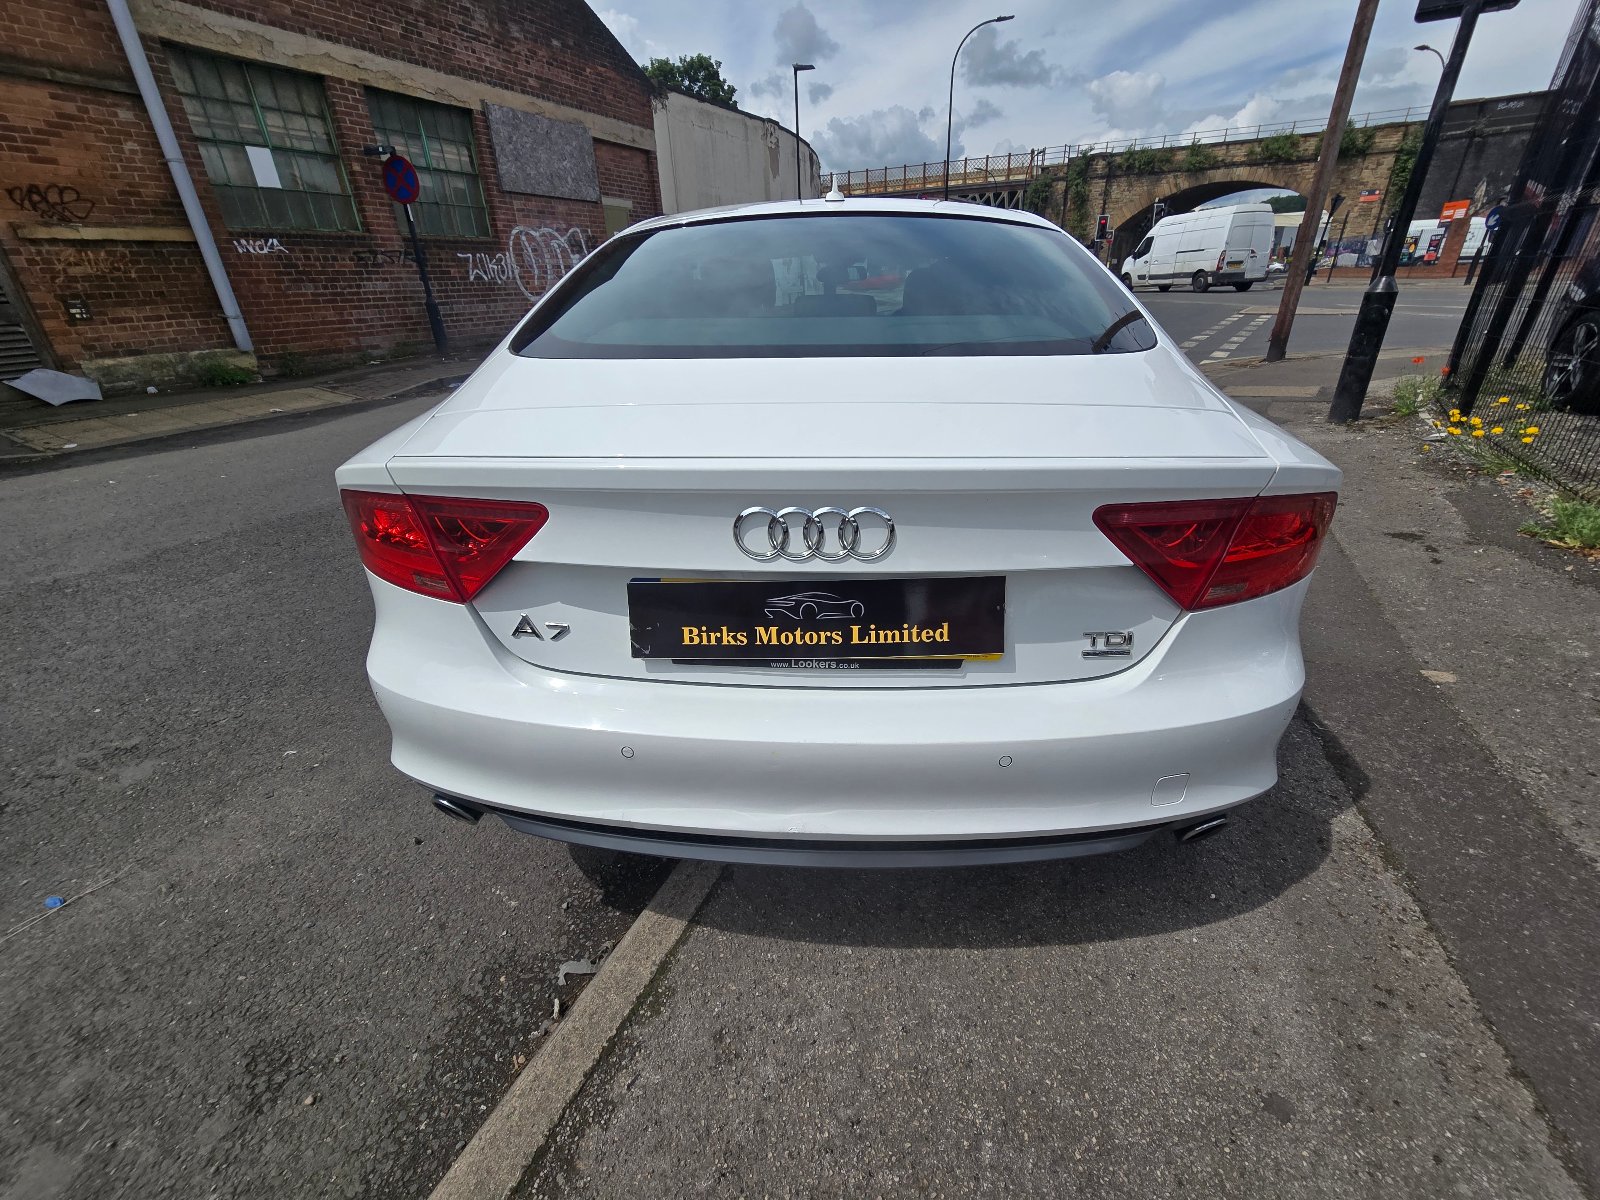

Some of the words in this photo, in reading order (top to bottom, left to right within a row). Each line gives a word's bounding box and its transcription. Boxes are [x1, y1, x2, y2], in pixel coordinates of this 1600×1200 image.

[511, 612, 571, 642] A7
[681, 625, 748, 646] Birks
[755, 625, 843, 645] Motors
[850, 622, 951, 644] Limited
[1082, 631, 1134, 649] TDI
[770, 659, 860, 669] www.Lookers.co.uk
